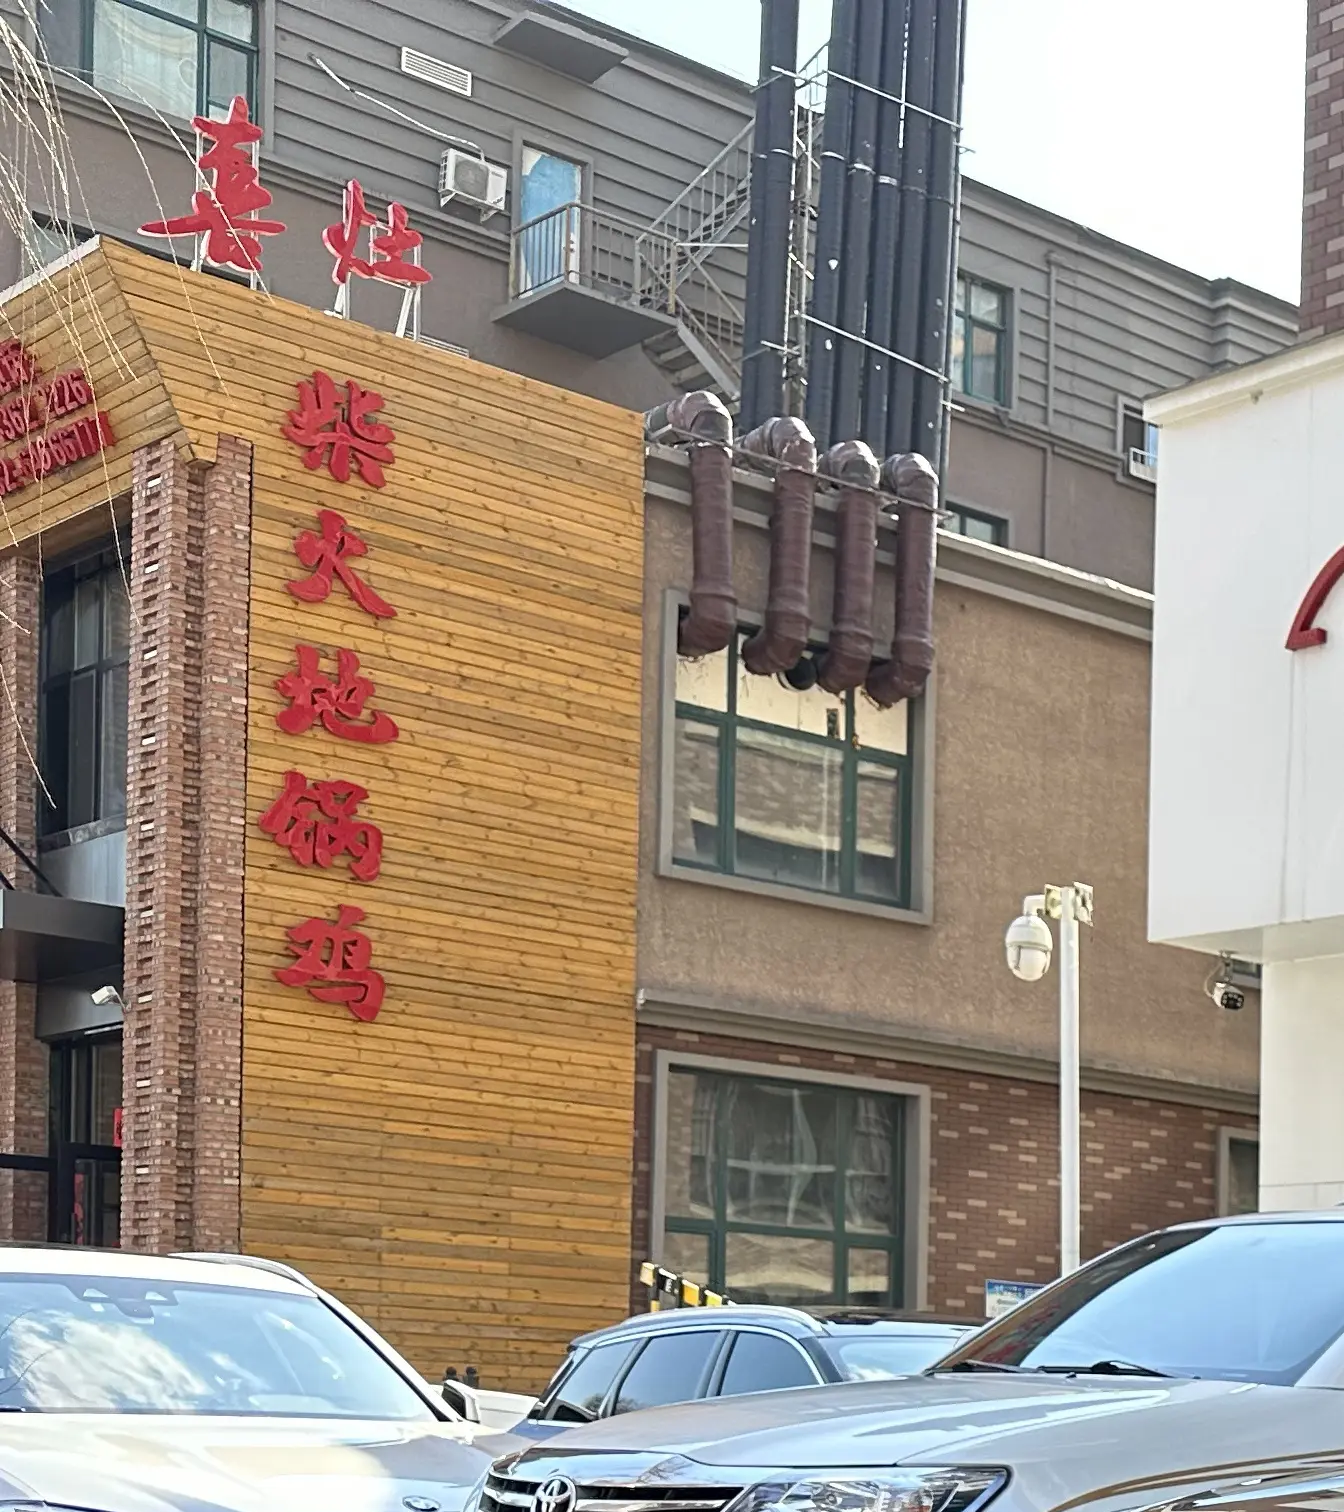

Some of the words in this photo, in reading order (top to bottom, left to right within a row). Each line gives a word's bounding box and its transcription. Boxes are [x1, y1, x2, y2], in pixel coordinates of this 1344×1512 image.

[258, 370, 399, 1023] 柴火地锅鸡
